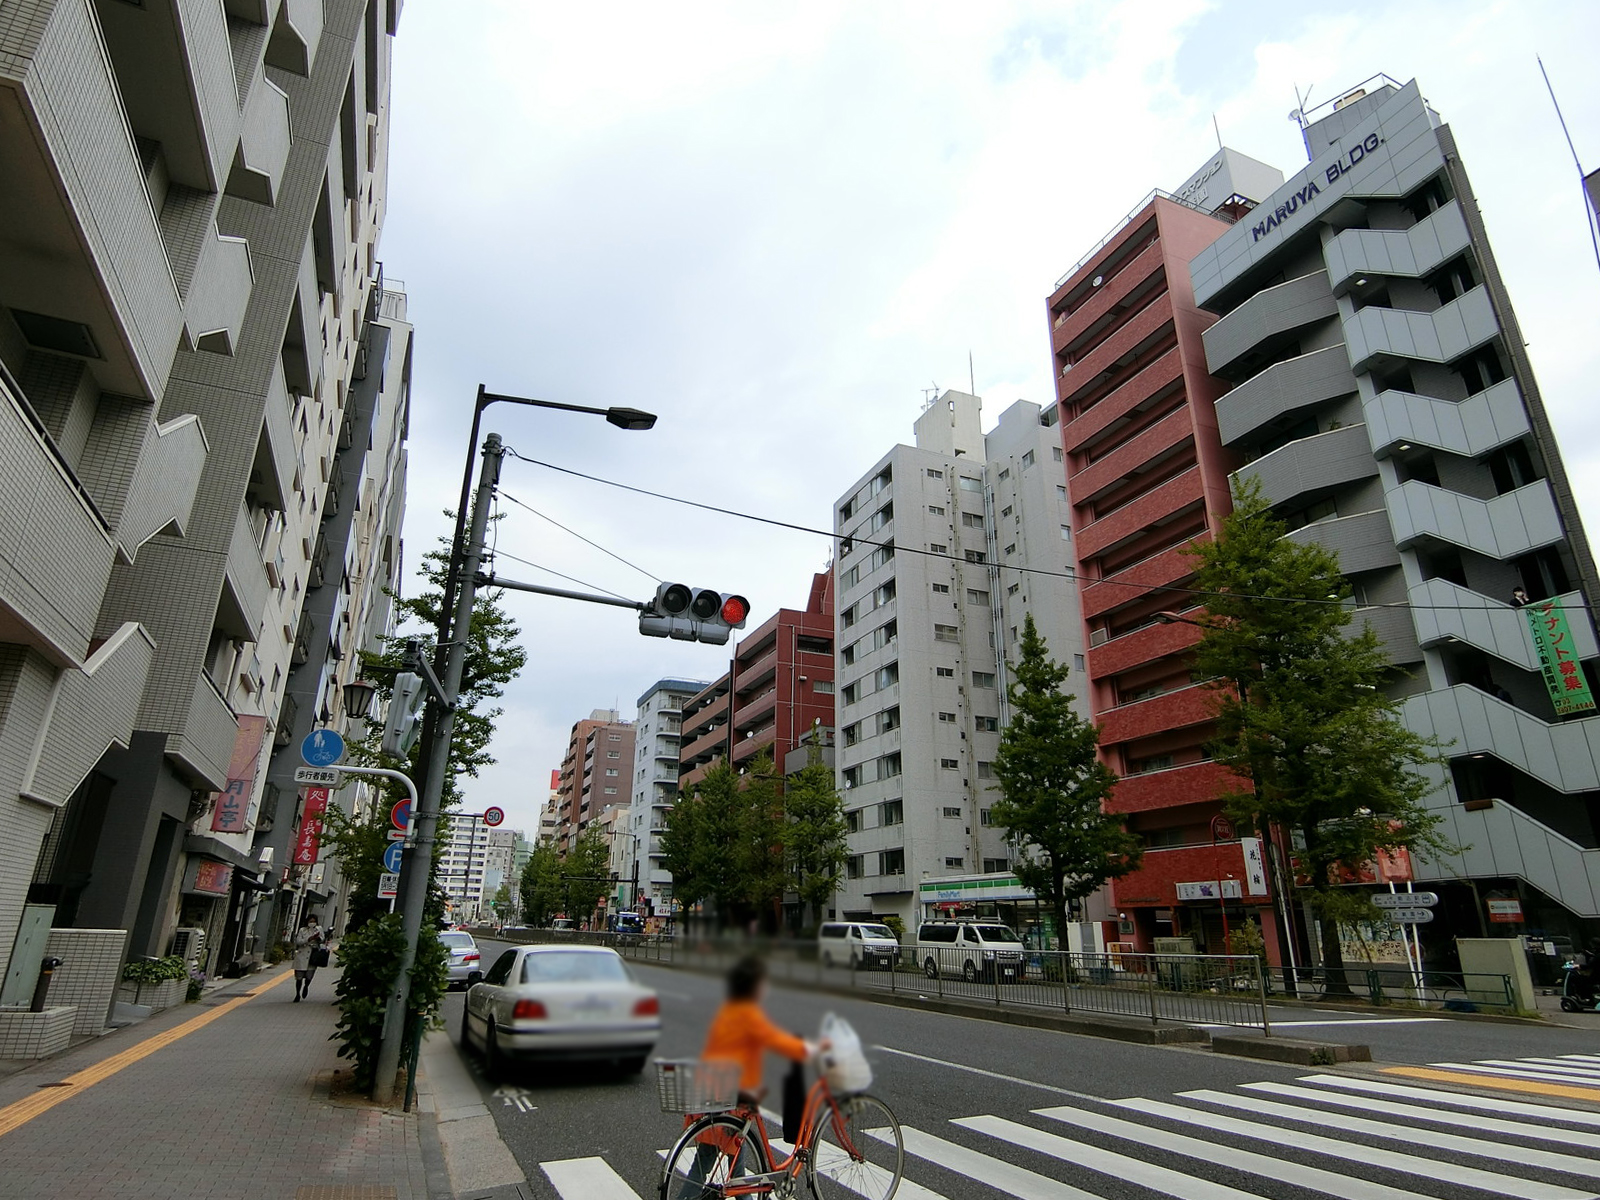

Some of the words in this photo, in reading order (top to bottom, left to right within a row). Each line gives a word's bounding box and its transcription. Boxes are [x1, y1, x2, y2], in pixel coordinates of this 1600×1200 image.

[1251, 182, 1320, 242] MARUYA
[1325, 133, 1385, 184] BLDG.
[1541, 602, 1583, 691] テナント募集
[298, 770, 335, 781] 歩行者優先
[219, 780, 244, 828] 月山亭
[488, 811, 500, 822] 50
